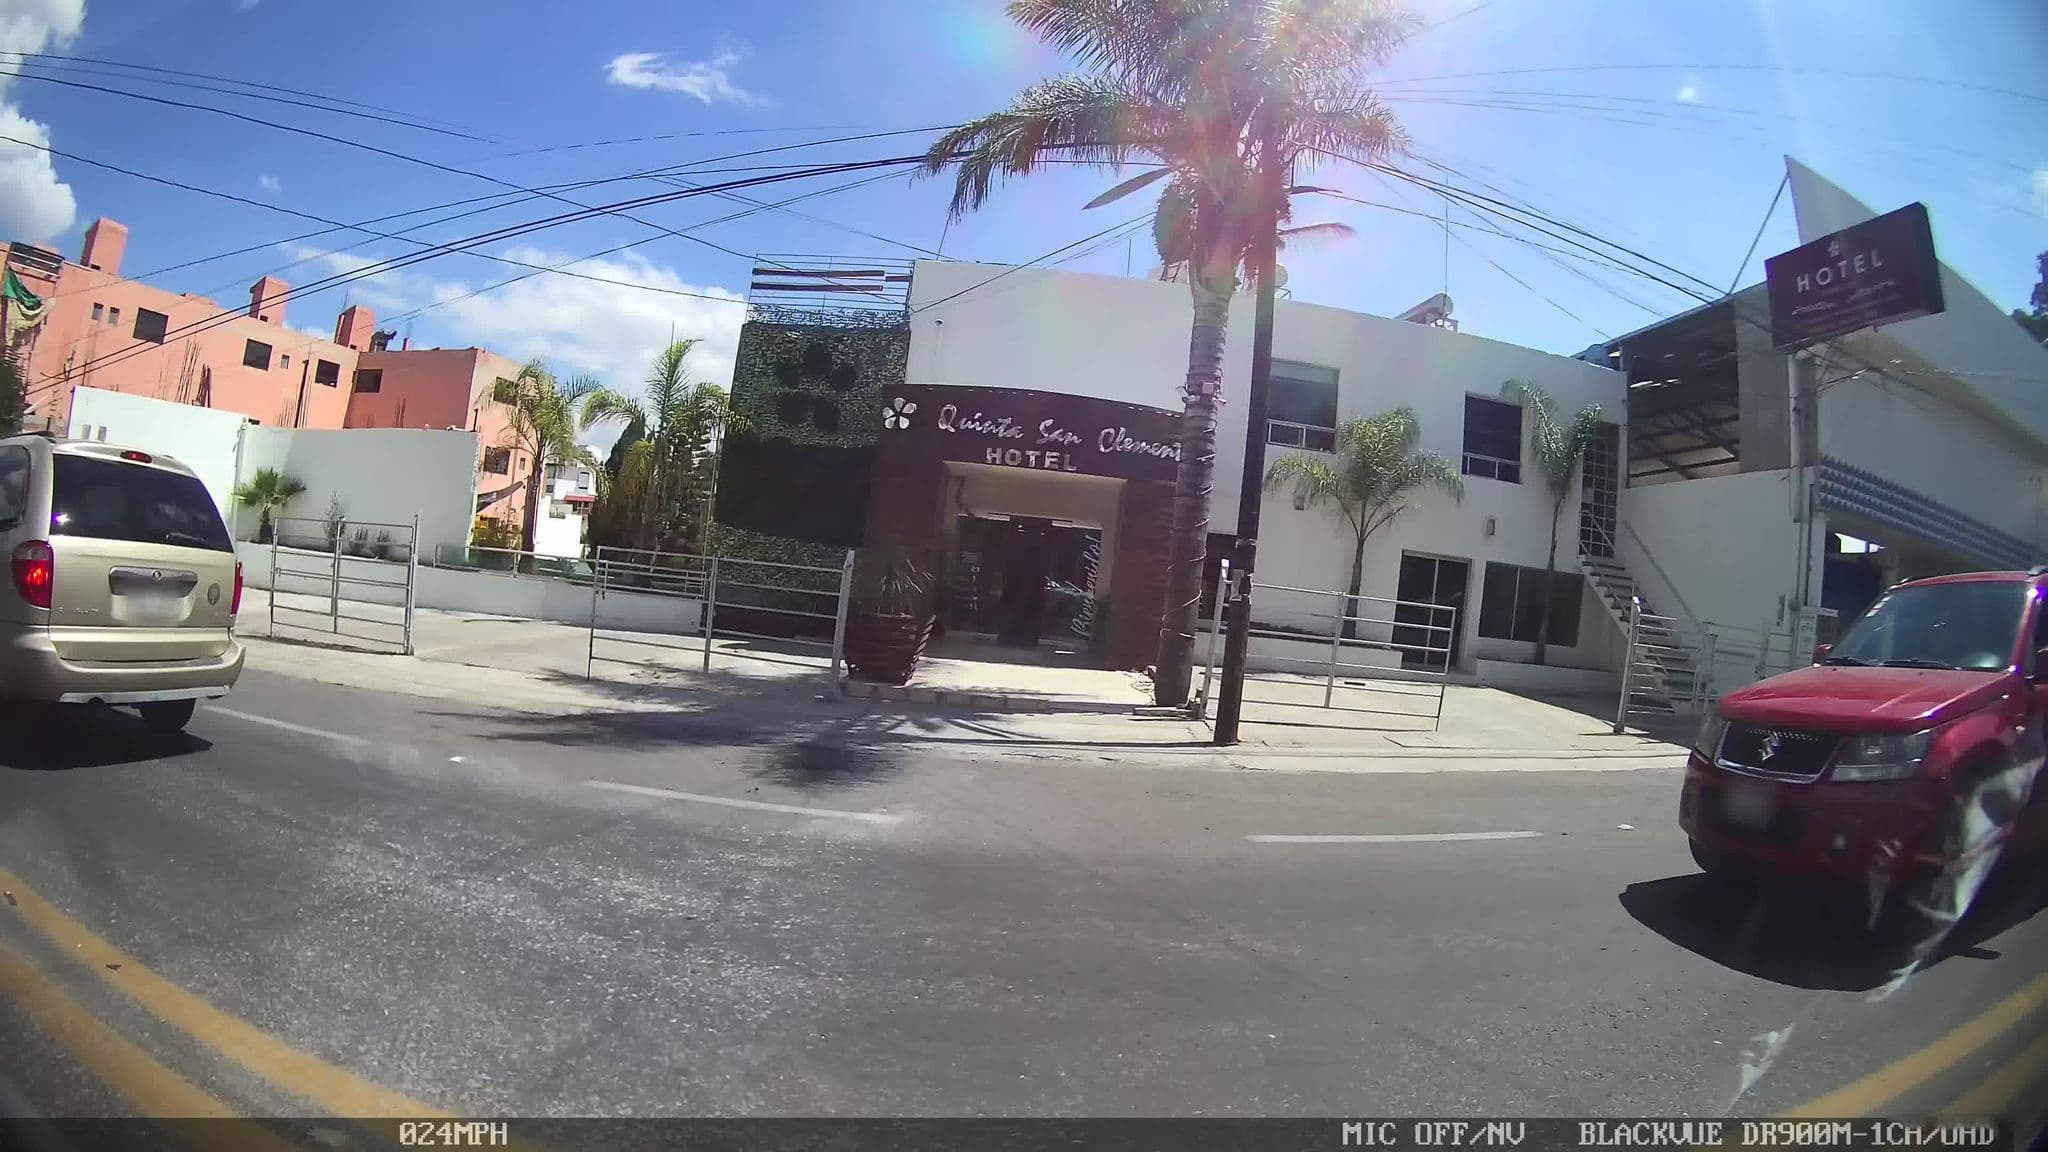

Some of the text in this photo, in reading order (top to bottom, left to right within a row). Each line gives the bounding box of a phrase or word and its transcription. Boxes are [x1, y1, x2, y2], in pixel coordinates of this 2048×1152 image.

[1796, 248, 1882, 293] HOTEL
[937, 403, 1024, 439] Quinta
[1036, 418, 1083, 445] San
[985, 447, 1077, 471] HOTEL
